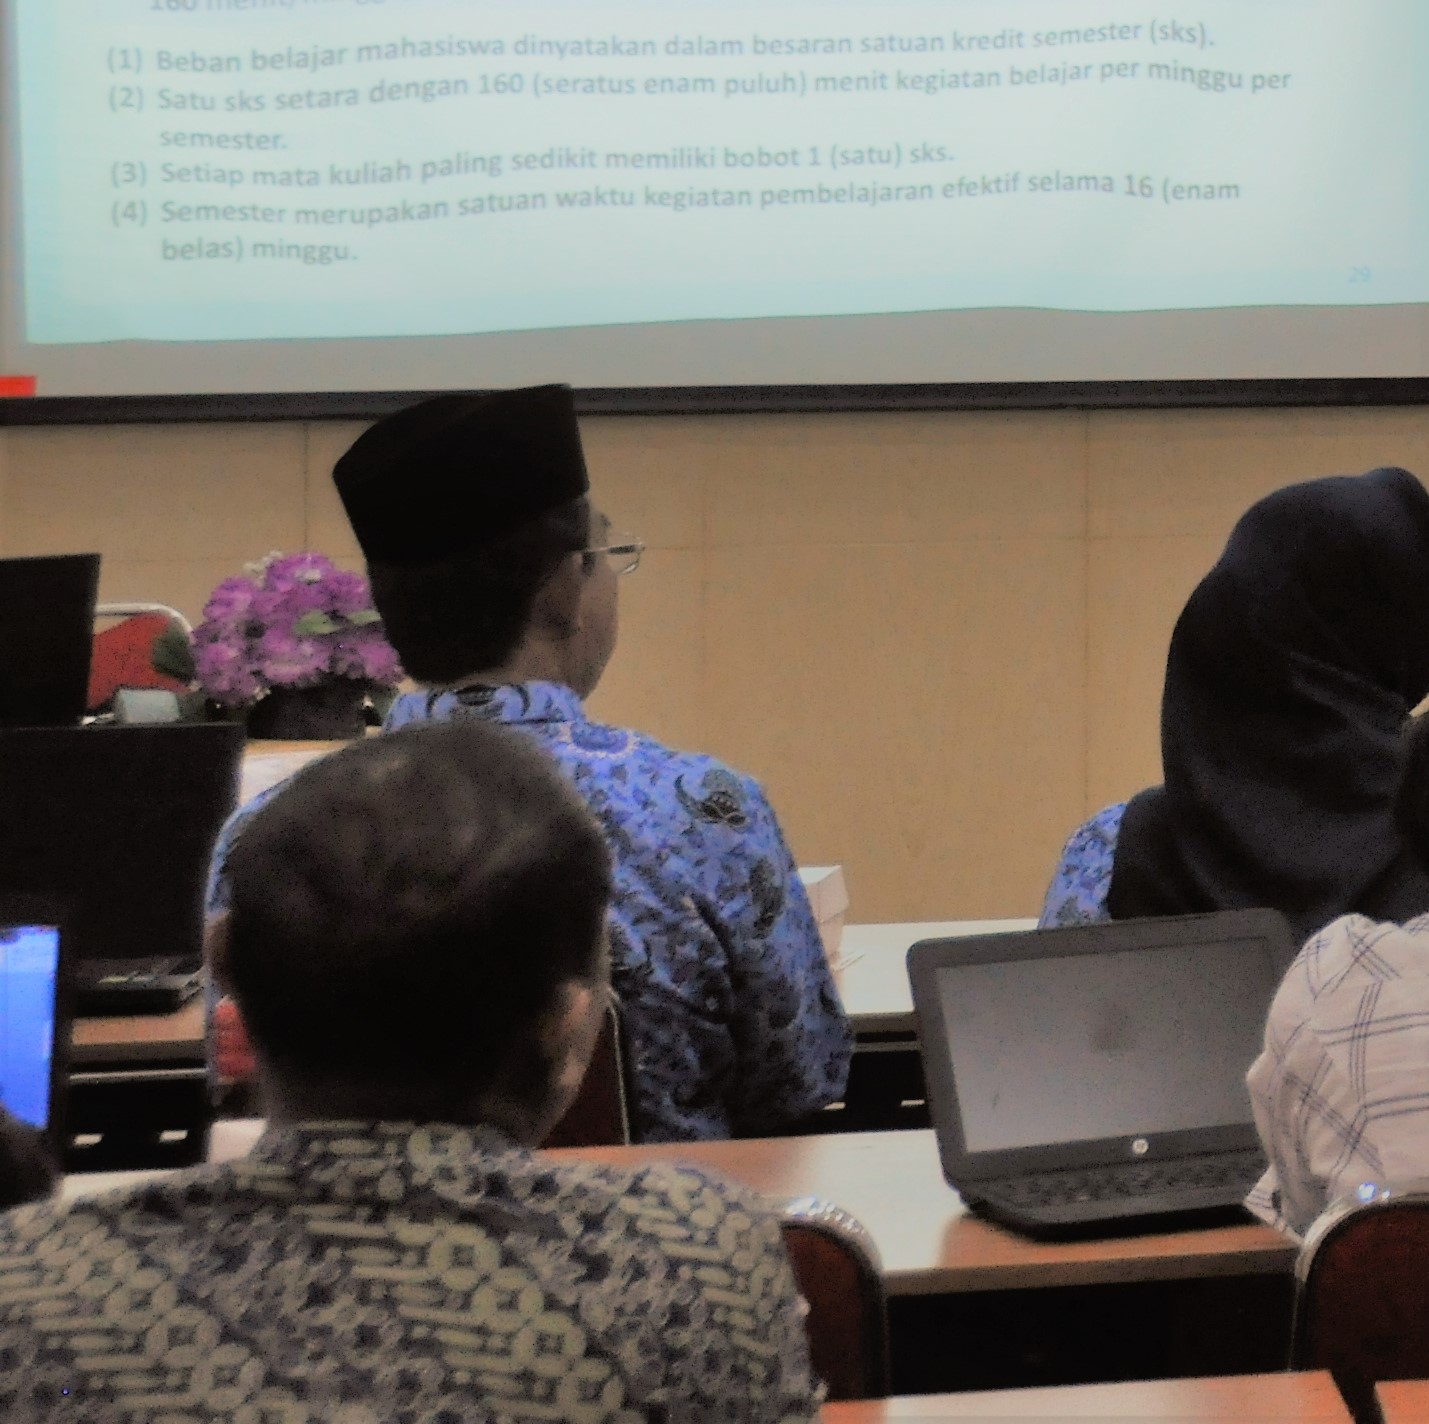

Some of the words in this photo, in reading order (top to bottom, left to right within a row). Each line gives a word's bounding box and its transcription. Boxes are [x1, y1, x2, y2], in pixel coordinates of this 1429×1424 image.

[106, 47, 144, 74] (1)
[156, 47, 242, 71] Beban
[250, 42, 348, 72] belajar
[356, 35, 505, 61] mahasiswa
[512, 35, 657, 61] dinyatakan
[664, 35, 744, 57] dalam
[752, 32, 853, 56] besaran
[860, 33, 944, 54] satuan
[952, 27, 1024, 52] kredit
[1031, 21, 1143, 46] semester
[1150, 18, 1215, 50] (sks).
[108, 86, 145, 114] (2)
[157, 88, 217, 111] Satu
[225, 89, 267, 111] sks
[275, 87, 360, 109] setara
[368, 73, 469, 106] dengan
[477, 73, 525, 96] 160
[532, 72, 636, 99] (seratus
[643, 76, 715, 95] enam
[723, 71, 807, 99] puluh)
[814, 71, 888, 92] menit
[896, 67, 1002, 95] kegiatan
[1010, 59, 1093, 89] belajar
[1100, 62, 1140, 83] per
[1147, 58, 1243, 92] minggu
[1251, 71, 1292, 93] per
[110, 161, 147, 189] (3)
[160, 161, 244, 189] Setiap
[251, 164, 320, 185] mata
[329, 158, 412, 185] kuliah
[420, 151, 503, 181] paling
[511, 146, 597, 172] sedikit
[605, 146, 715, 169] memiliki
[723, 145, 800, 168] bobot
[807, 145, 820, 166] 1
[829, 142, 903, 170] (satu)
[910, 141, 956, 164] sks.
[160, 128, 288, 152] semester.
[110, 199, 148, 228] (4)
[161, 201, 286, 225] Semester
[294, 198, 449, 228] merupakan
[457, 189, 548, 215] satuan
[556, 186, 636, 209] waktu
[644, 183, 752, 211] kegiatan
[760, 179, 934, 209] pembelajaran
[941, 171, 1020, 199] efektif
[1027, 169, 1115, 194] selama
[1123, 173, 1154, 198] 16
[1161, 176, 1240, 204] (enam
[161, 234, 244, 264] belas)
[251, 238, 358, 265] minggu.
